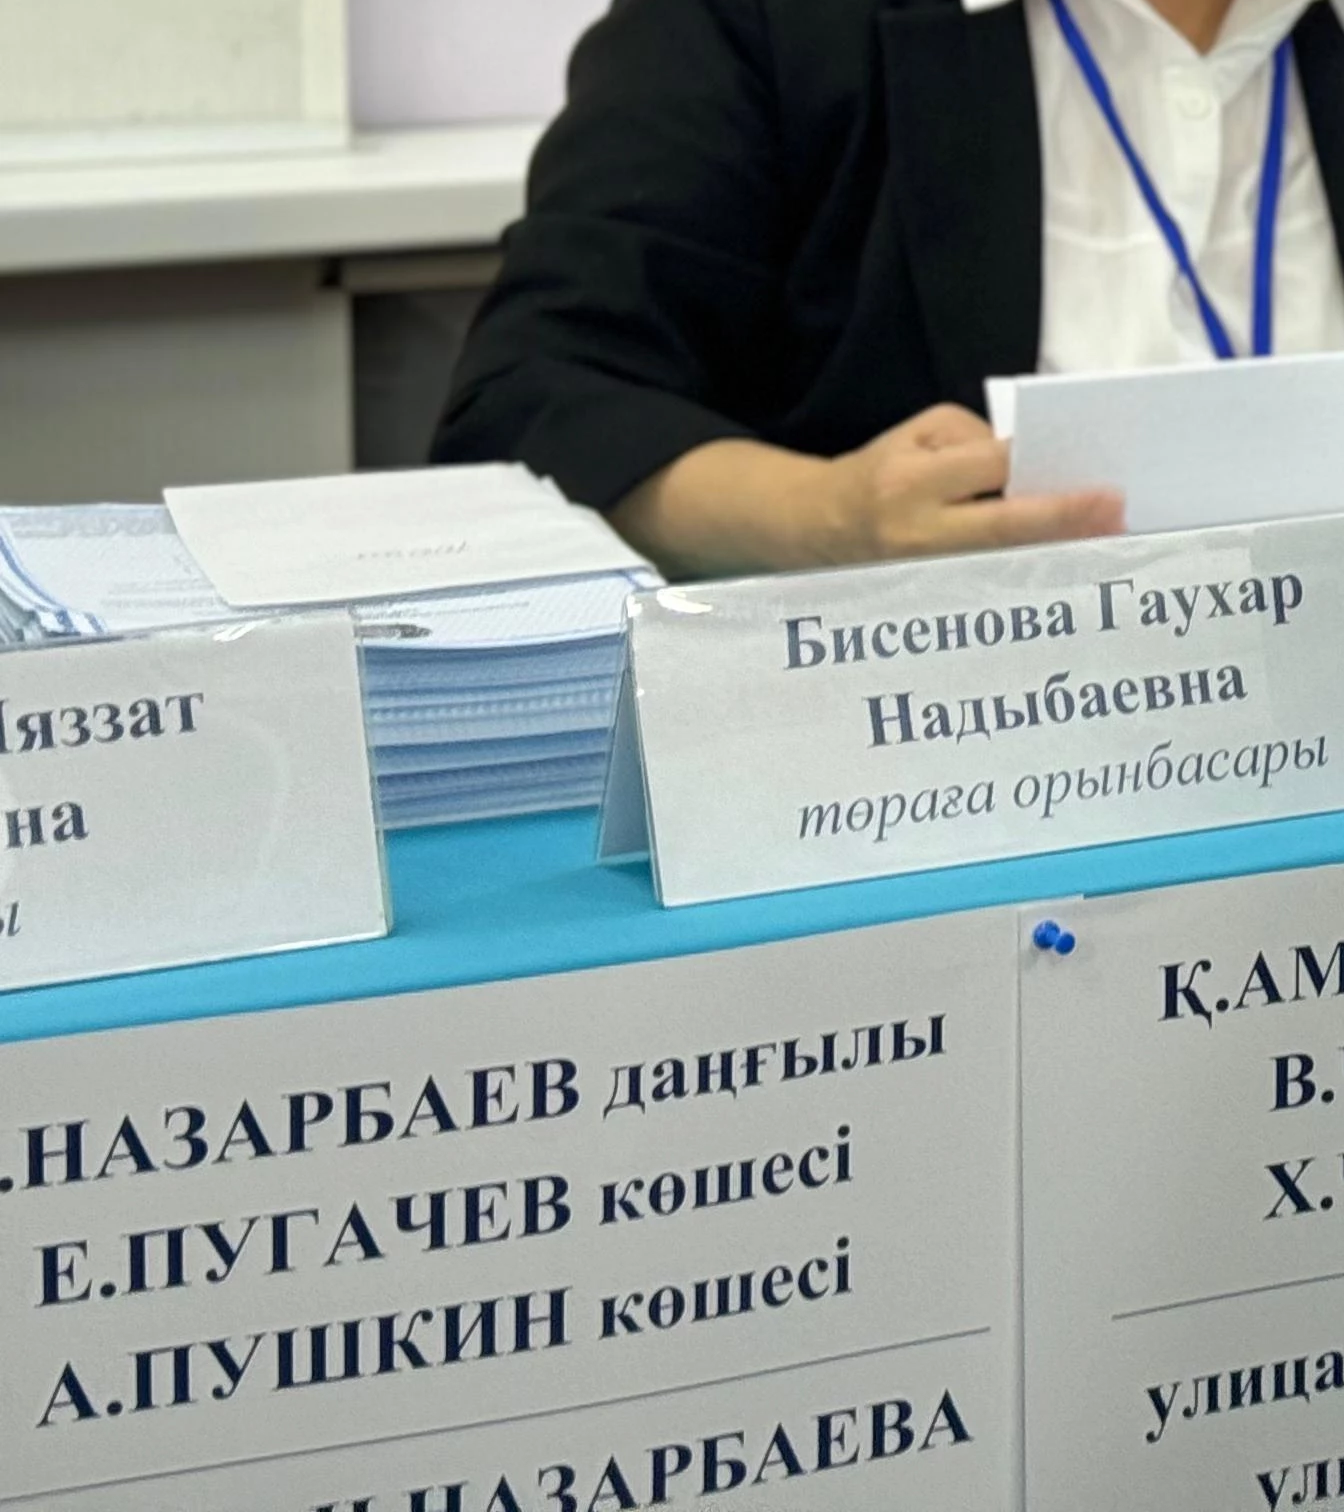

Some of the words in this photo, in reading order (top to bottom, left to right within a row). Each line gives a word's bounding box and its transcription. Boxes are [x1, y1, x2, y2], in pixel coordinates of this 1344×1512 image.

[781, 598, 1077, 671] Бисенова
[1098, 572, 1304, 636] Гаухар
[863, 661, 1249, 749] Надыбаевна
[1012, 734, 1330, 820] орынбасары
[0, 1056, 581, 1194] .НАЗАРБАЕВ
[602, 1011, 948, 1119] даңғылы
[32, 1173, 572, 1309] Е.ПУГАЧЕВ
[598, 1122, 855, 1227] көшесі
[35, 1286, 573, 1431] А.ПУШКИН
[598, 1234, 855, 1341] көшесі
